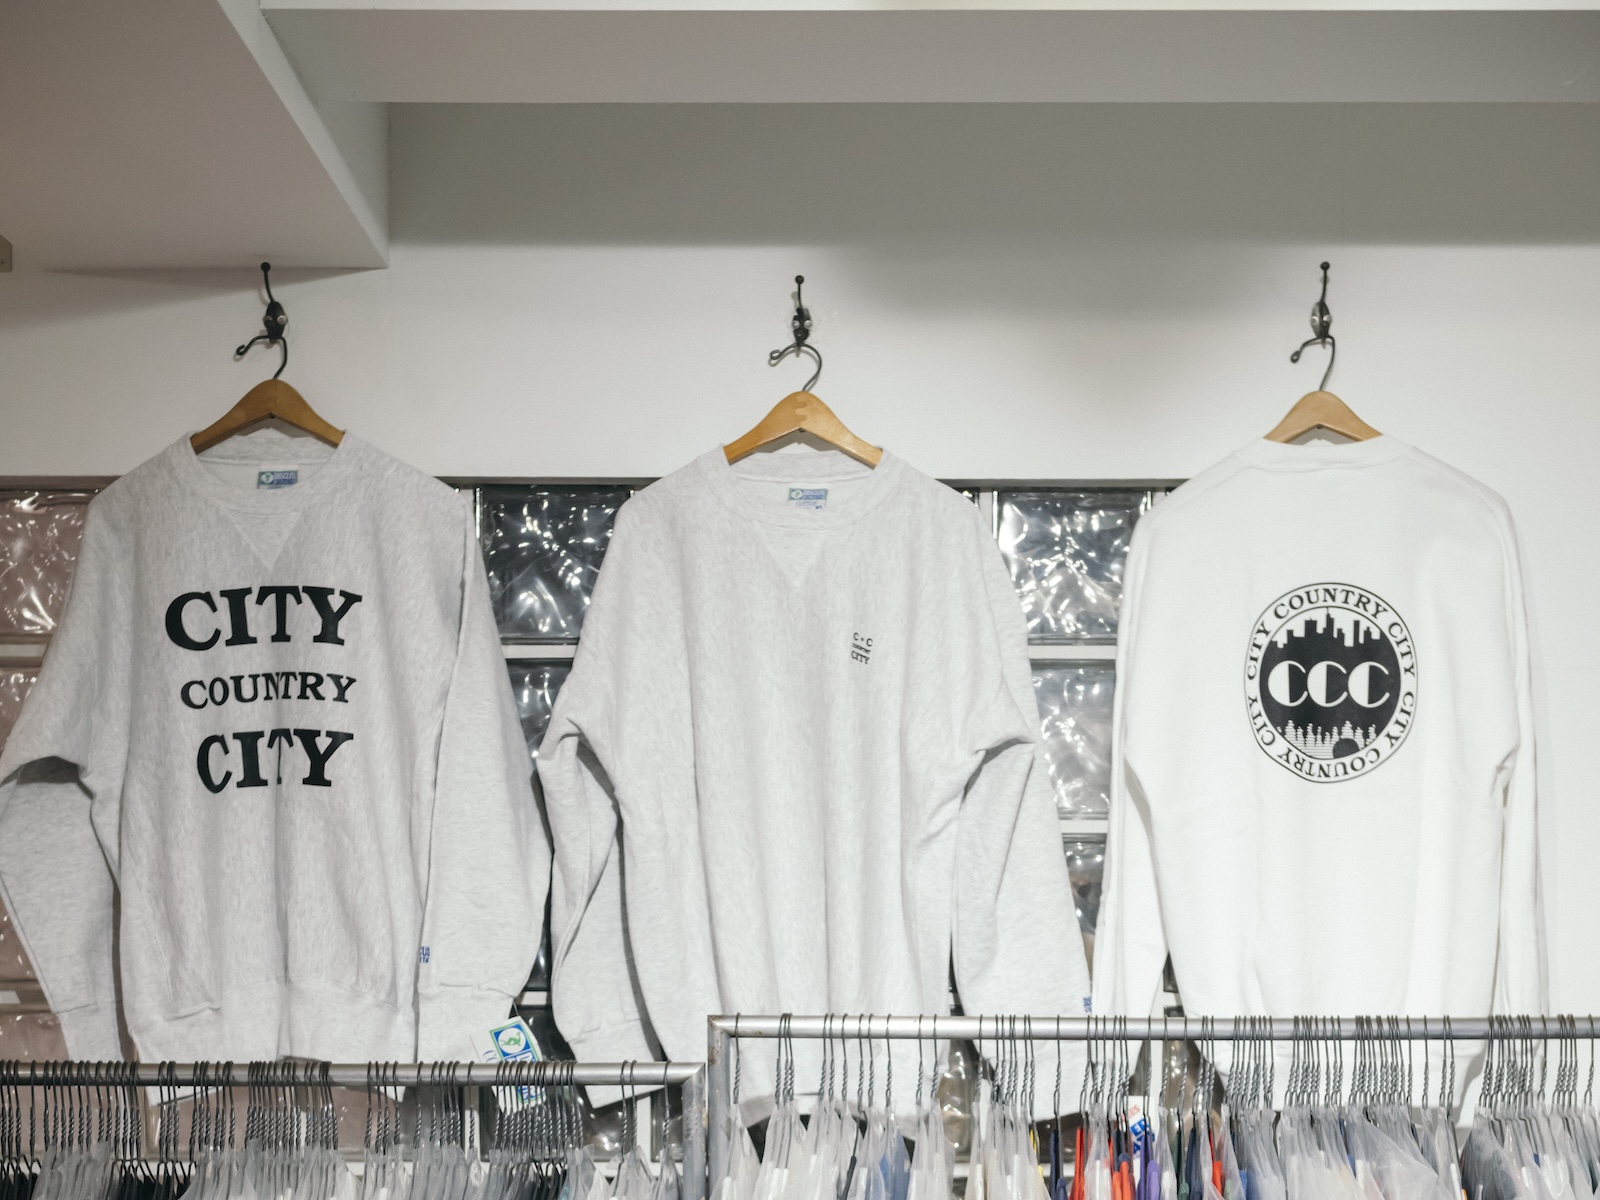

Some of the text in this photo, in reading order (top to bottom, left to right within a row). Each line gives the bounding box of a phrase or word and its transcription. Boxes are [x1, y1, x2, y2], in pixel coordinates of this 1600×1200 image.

[165, 586, 362, 651] CITY
[1247, 588, 1415, 680] CITY COUNTRY CITY
[180, 672, 356, 709] COUNTRY
[196, 728, 353, 793] CITY
[1248, 691, 1414, 778] CITY COUNTRY CITY
